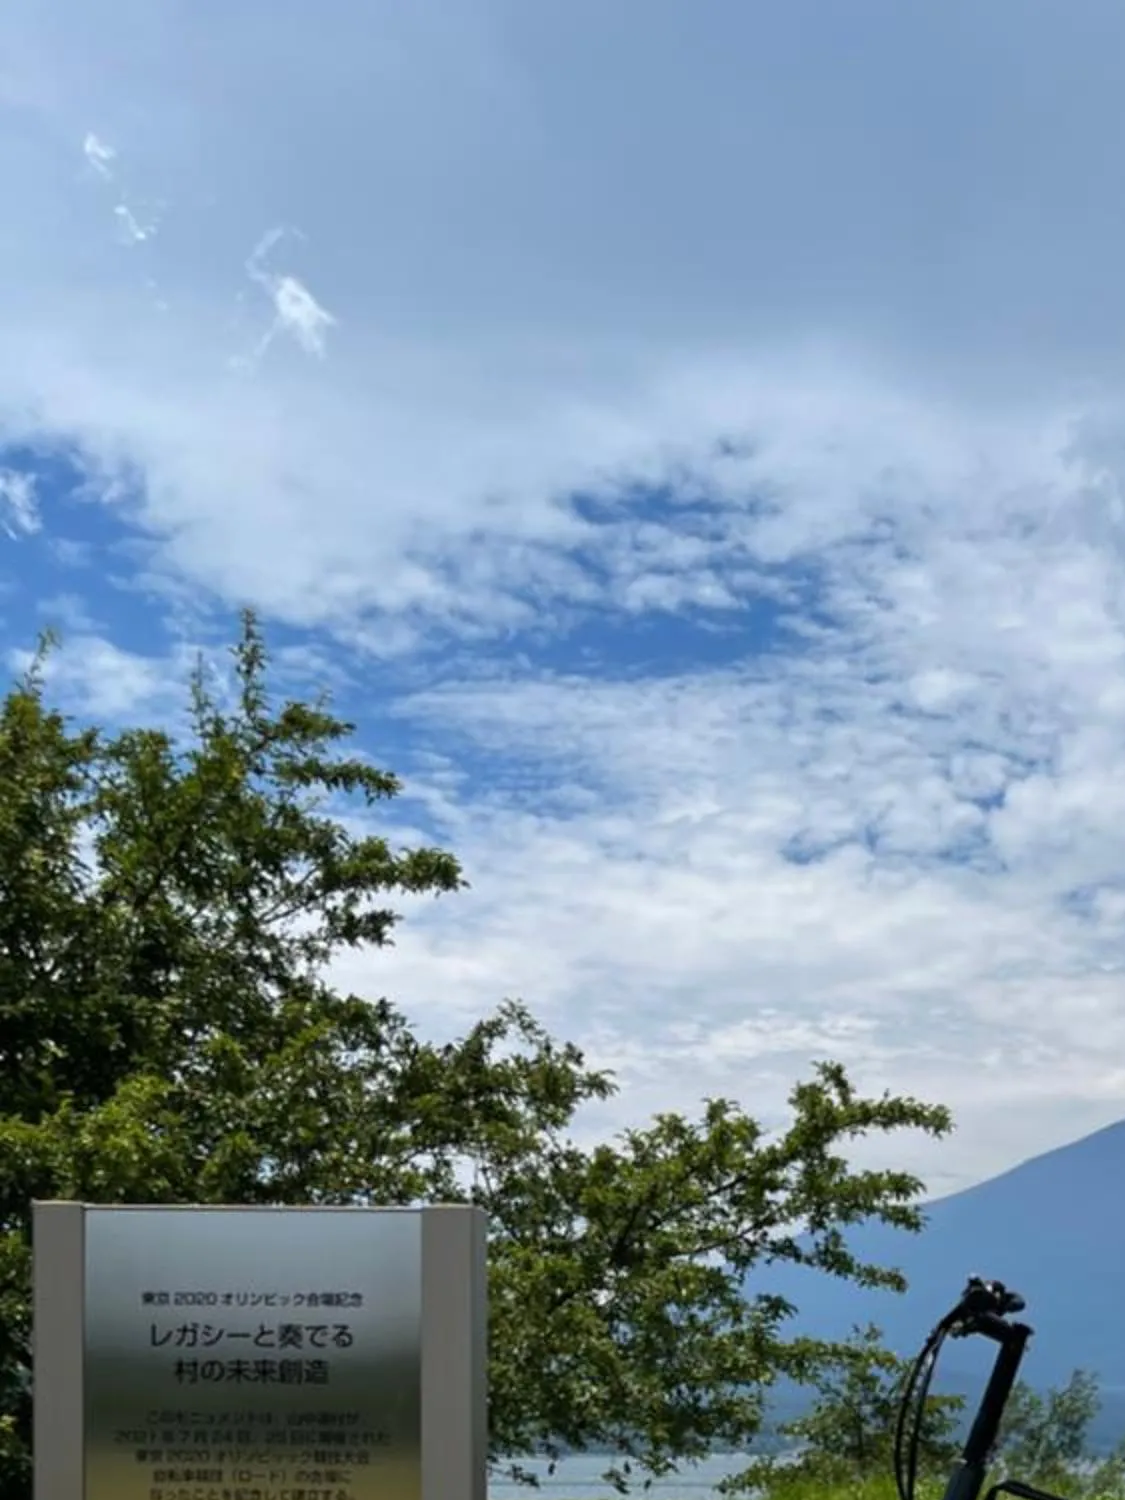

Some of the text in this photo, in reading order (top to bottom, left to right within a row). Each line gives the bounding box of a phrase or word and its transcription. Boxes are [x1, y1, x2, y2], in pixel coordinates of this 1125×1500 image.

[150, 1323, 354, 1349] レガシーと奏でる
[173, 1359, 329, 1385] 村の未来創造
